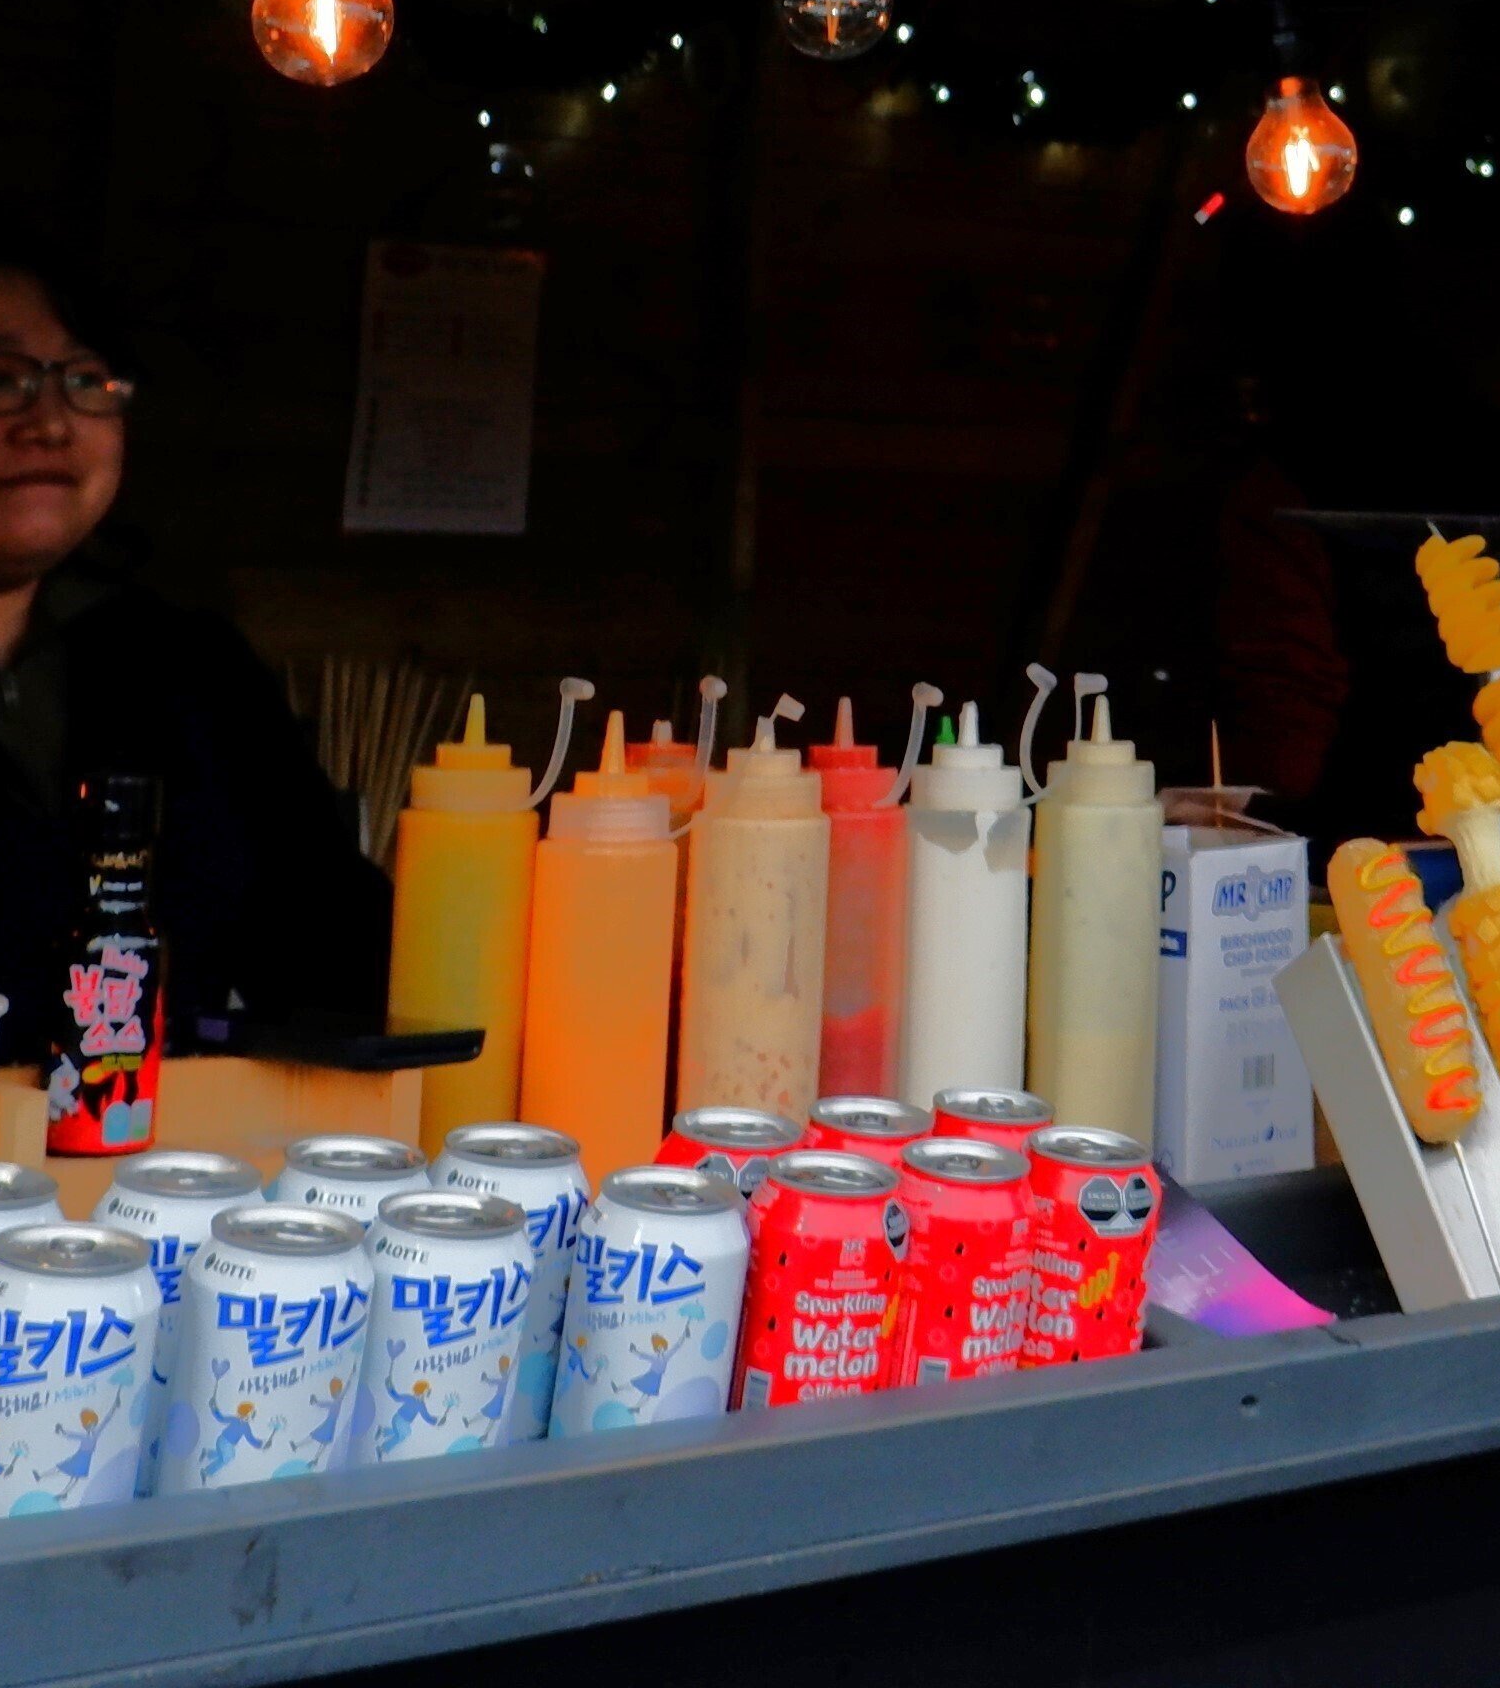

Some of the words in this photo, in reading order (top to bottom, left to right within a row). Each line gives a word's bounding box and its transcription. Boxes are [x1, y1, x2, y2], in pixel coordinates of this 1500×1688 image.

[457, 1173, 500, 1192] LOTTE
[117, 1203, 157, 1224] LOTTE
[319, 1192, 366, 1207] LOTTE
[213, 1255, 257, 1281] LOTTE
[386, 1241, 430, 1264] LOTTE
[577, 1231, 706, 1307] 밀키스
[391, 1261, 531, 1349] 밀키스
[795, 1290, 886, 1321] Sparkling
[216, 1278, 370, 1369] 밀키스
[792, 1314, 881, 1352] Water
[783, 1349, 879, 1380] melon
